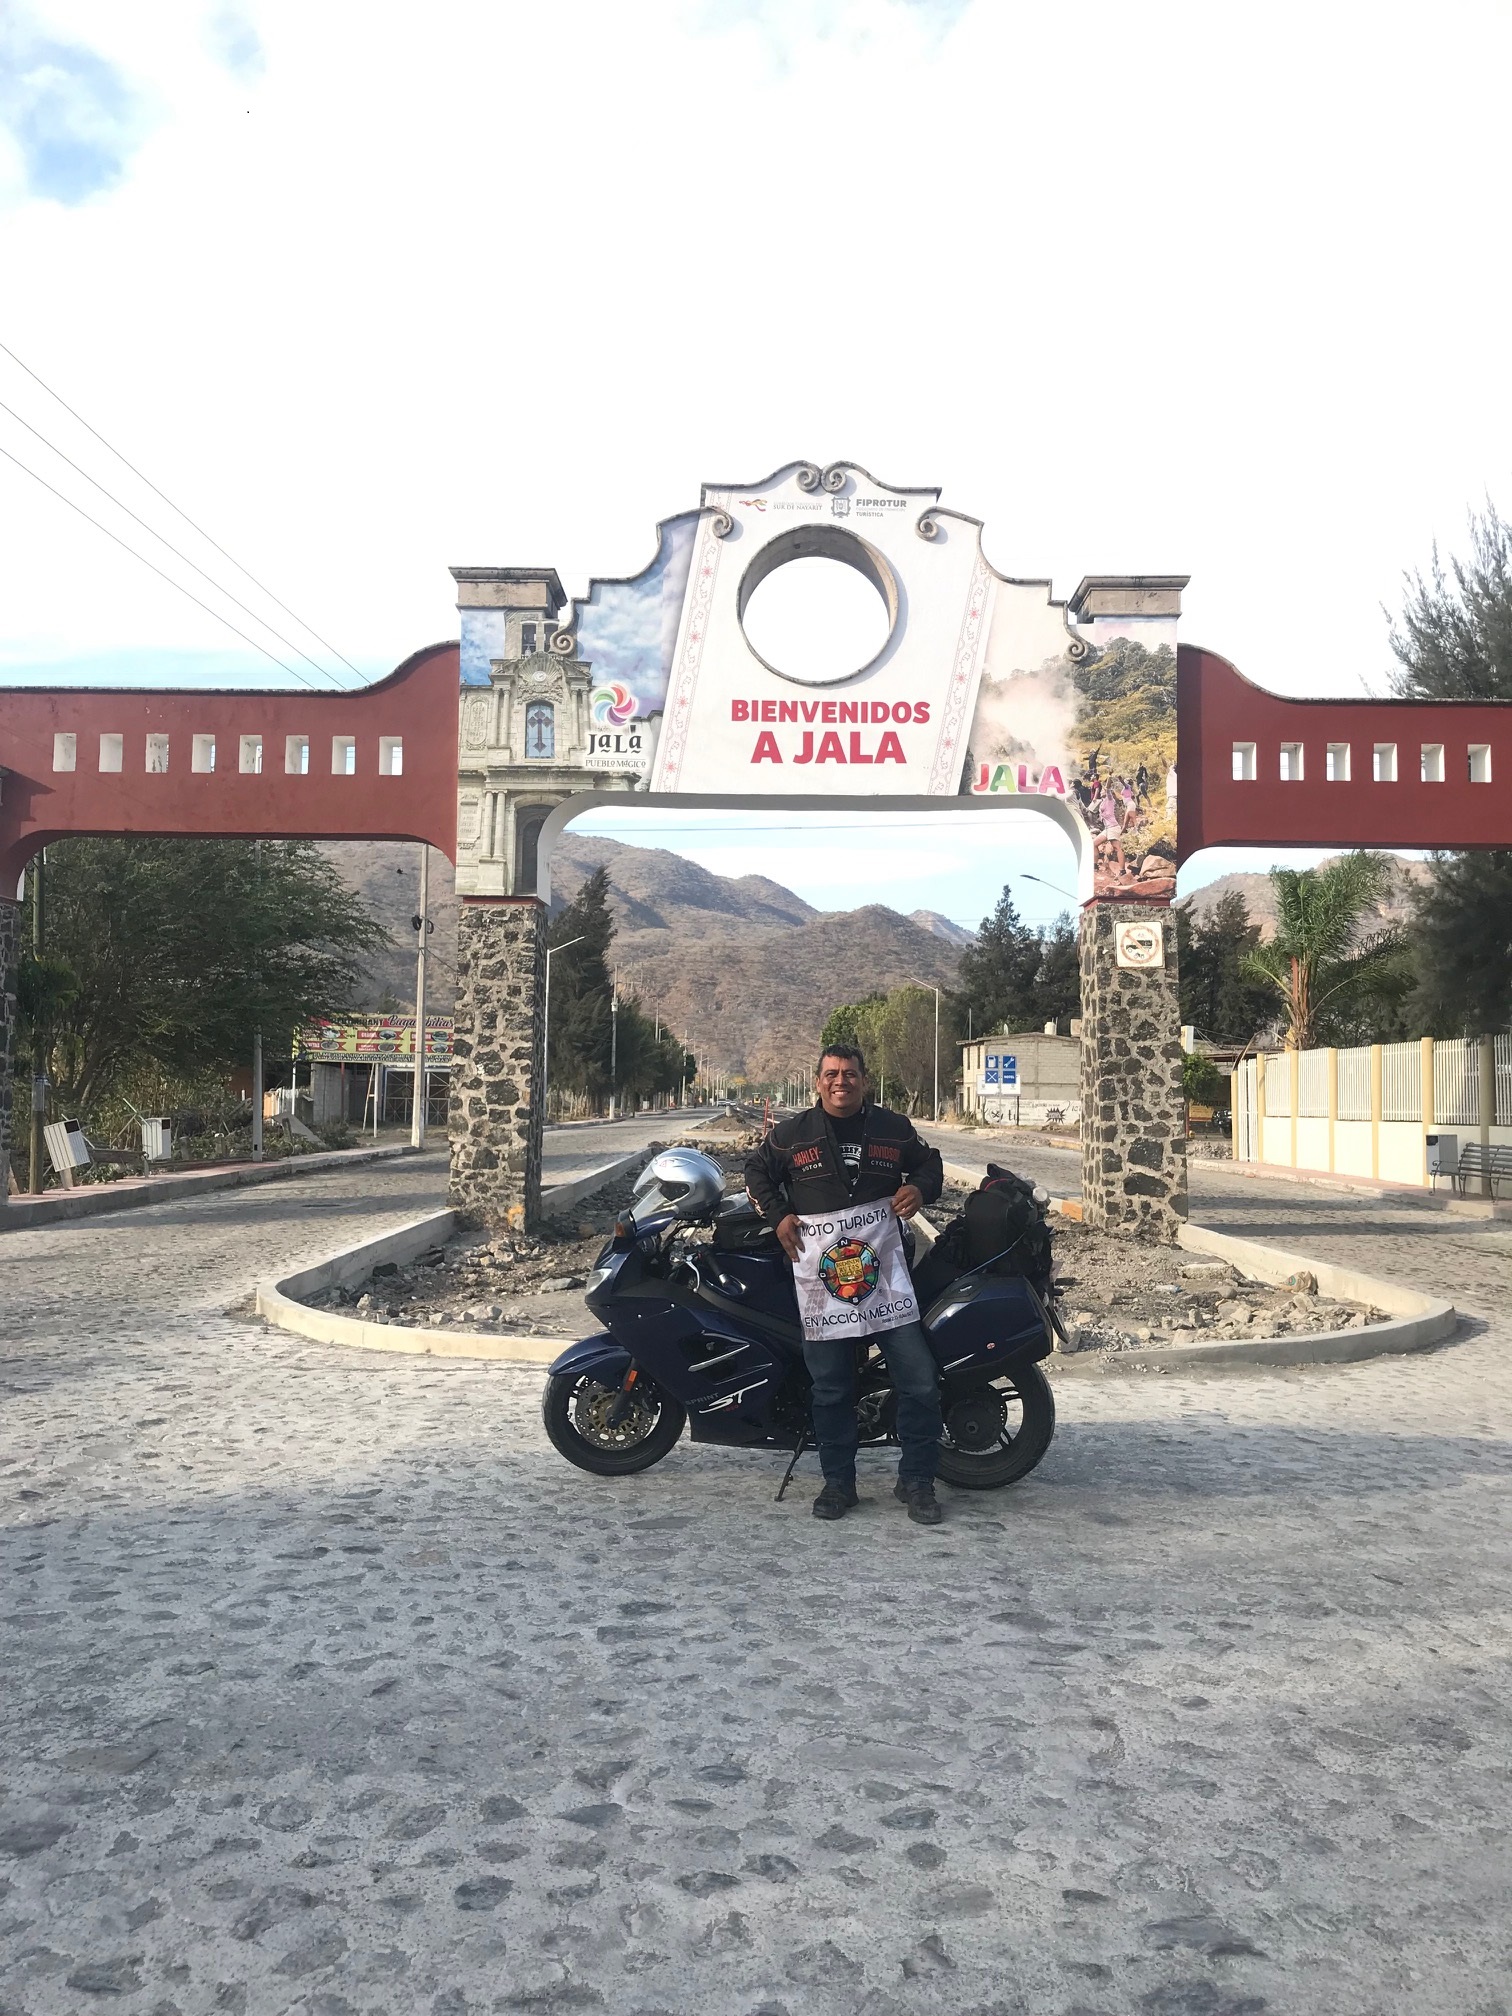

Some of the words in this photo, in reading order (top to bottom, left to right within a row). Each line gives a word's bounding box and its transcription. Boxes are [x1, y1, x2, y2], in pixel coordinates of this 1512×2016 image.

[856, 498, 907, 507] FIPROTUR
[731, 699, 930, 724] BIENVENIDOS
[750, 731, 784, 764] A
[792, 731, 907, 764] JALA
[973, 763, 1066, 794] JALA
[387, 1014, 453, 1031] Bugabilias
[801, 1162, 823, 1172] MOTOR
[870, 1160, 893, 1169] CYCLES
[801, 1222, 834, 1237] MOTO
[837, 1208, 888, 1232] TURISTA
[804, 1316, 819, 1328] EN
[821, 1309, 868, 1327] ACCIÓN
[869, 1298, 913, 1319] MÉXICO
[684, 1392, 719, 1406] SPRINT
[698, 1378, 768, 1414] ST
